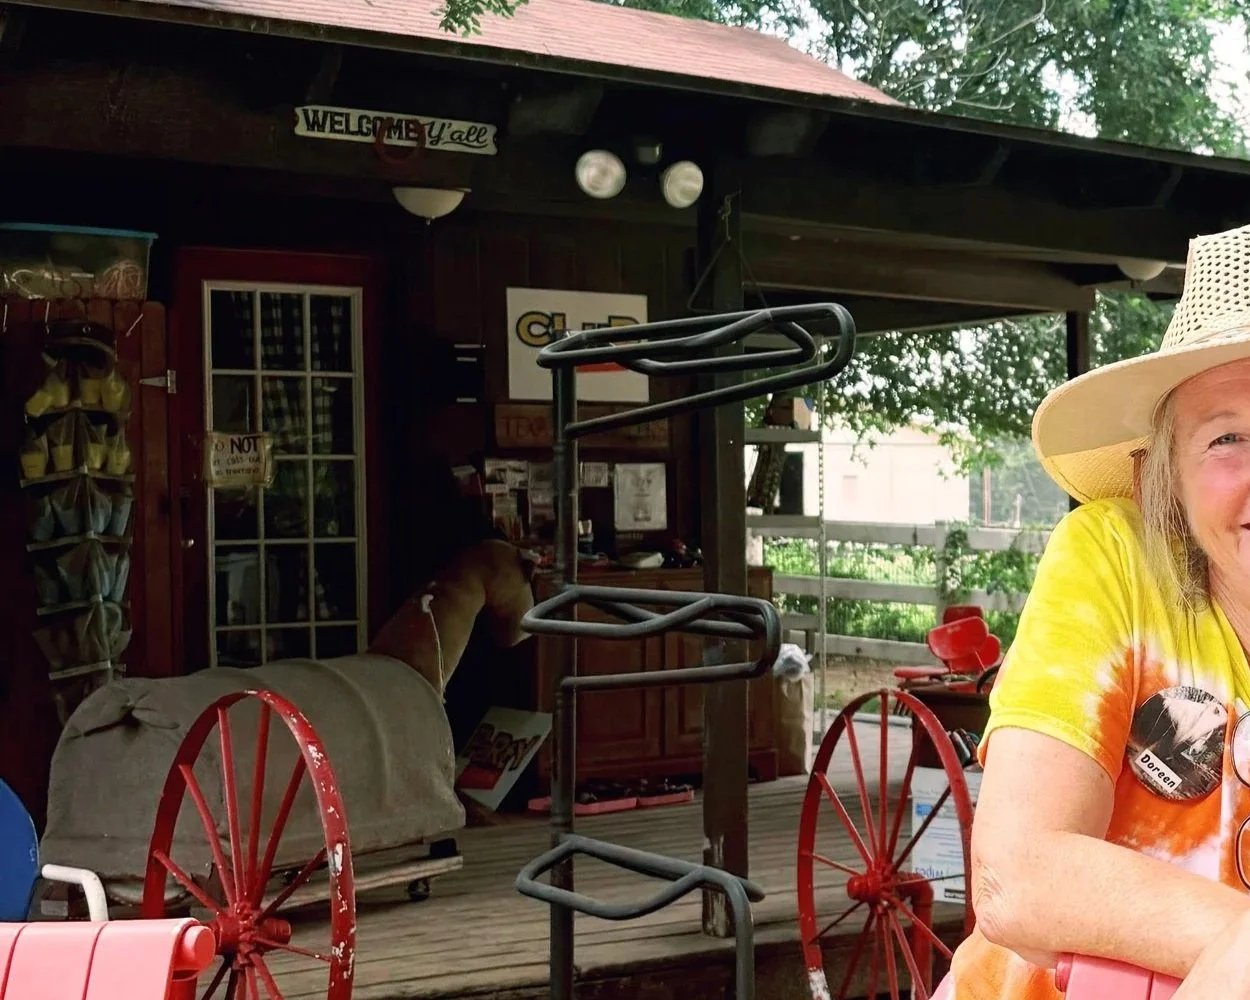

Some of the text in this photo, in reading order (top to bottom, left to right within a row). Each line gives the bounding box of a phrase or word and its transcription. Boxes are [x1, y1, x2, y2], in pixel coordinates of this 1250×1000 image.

[302, 108, 489, 147] WELCOME Y'all
[230, 436, 262, 454] NOT
[1140, 754, 1176, 788] Doreen
